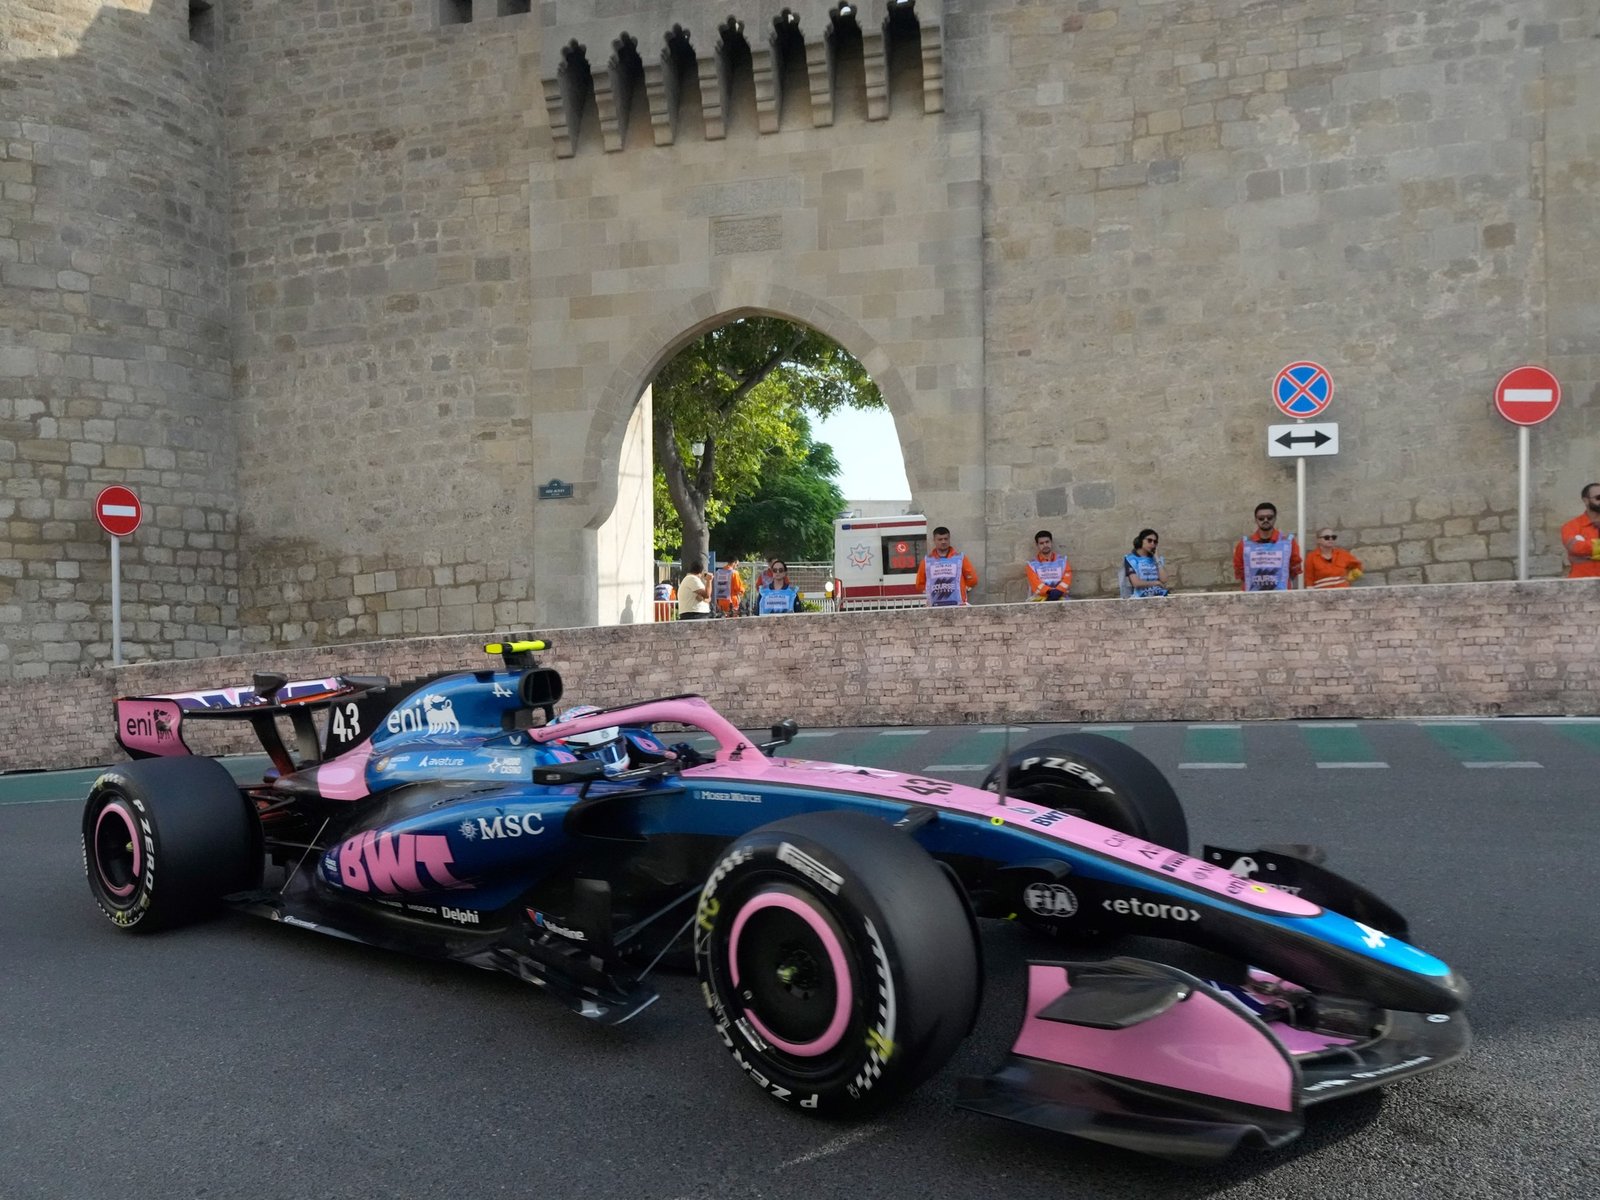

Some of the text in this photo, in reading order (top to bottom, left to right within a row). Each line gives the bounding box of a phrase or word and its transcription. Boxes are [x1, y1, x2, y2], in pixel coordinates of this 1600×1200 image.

[126, 711, 152, 737] eni
[333, 703, 361, 743] 43
[386, 698, 422, 733] eni
[899, 778, 953, 796] 43
[477, 812, 545, 840] MSC
[132, 798, 155, 892] P ZERO
[339, 830, 470, 895] BWT
[441, 906, 480, 924] Delphi
[716, 1023, 818, 1108] P ZERO
